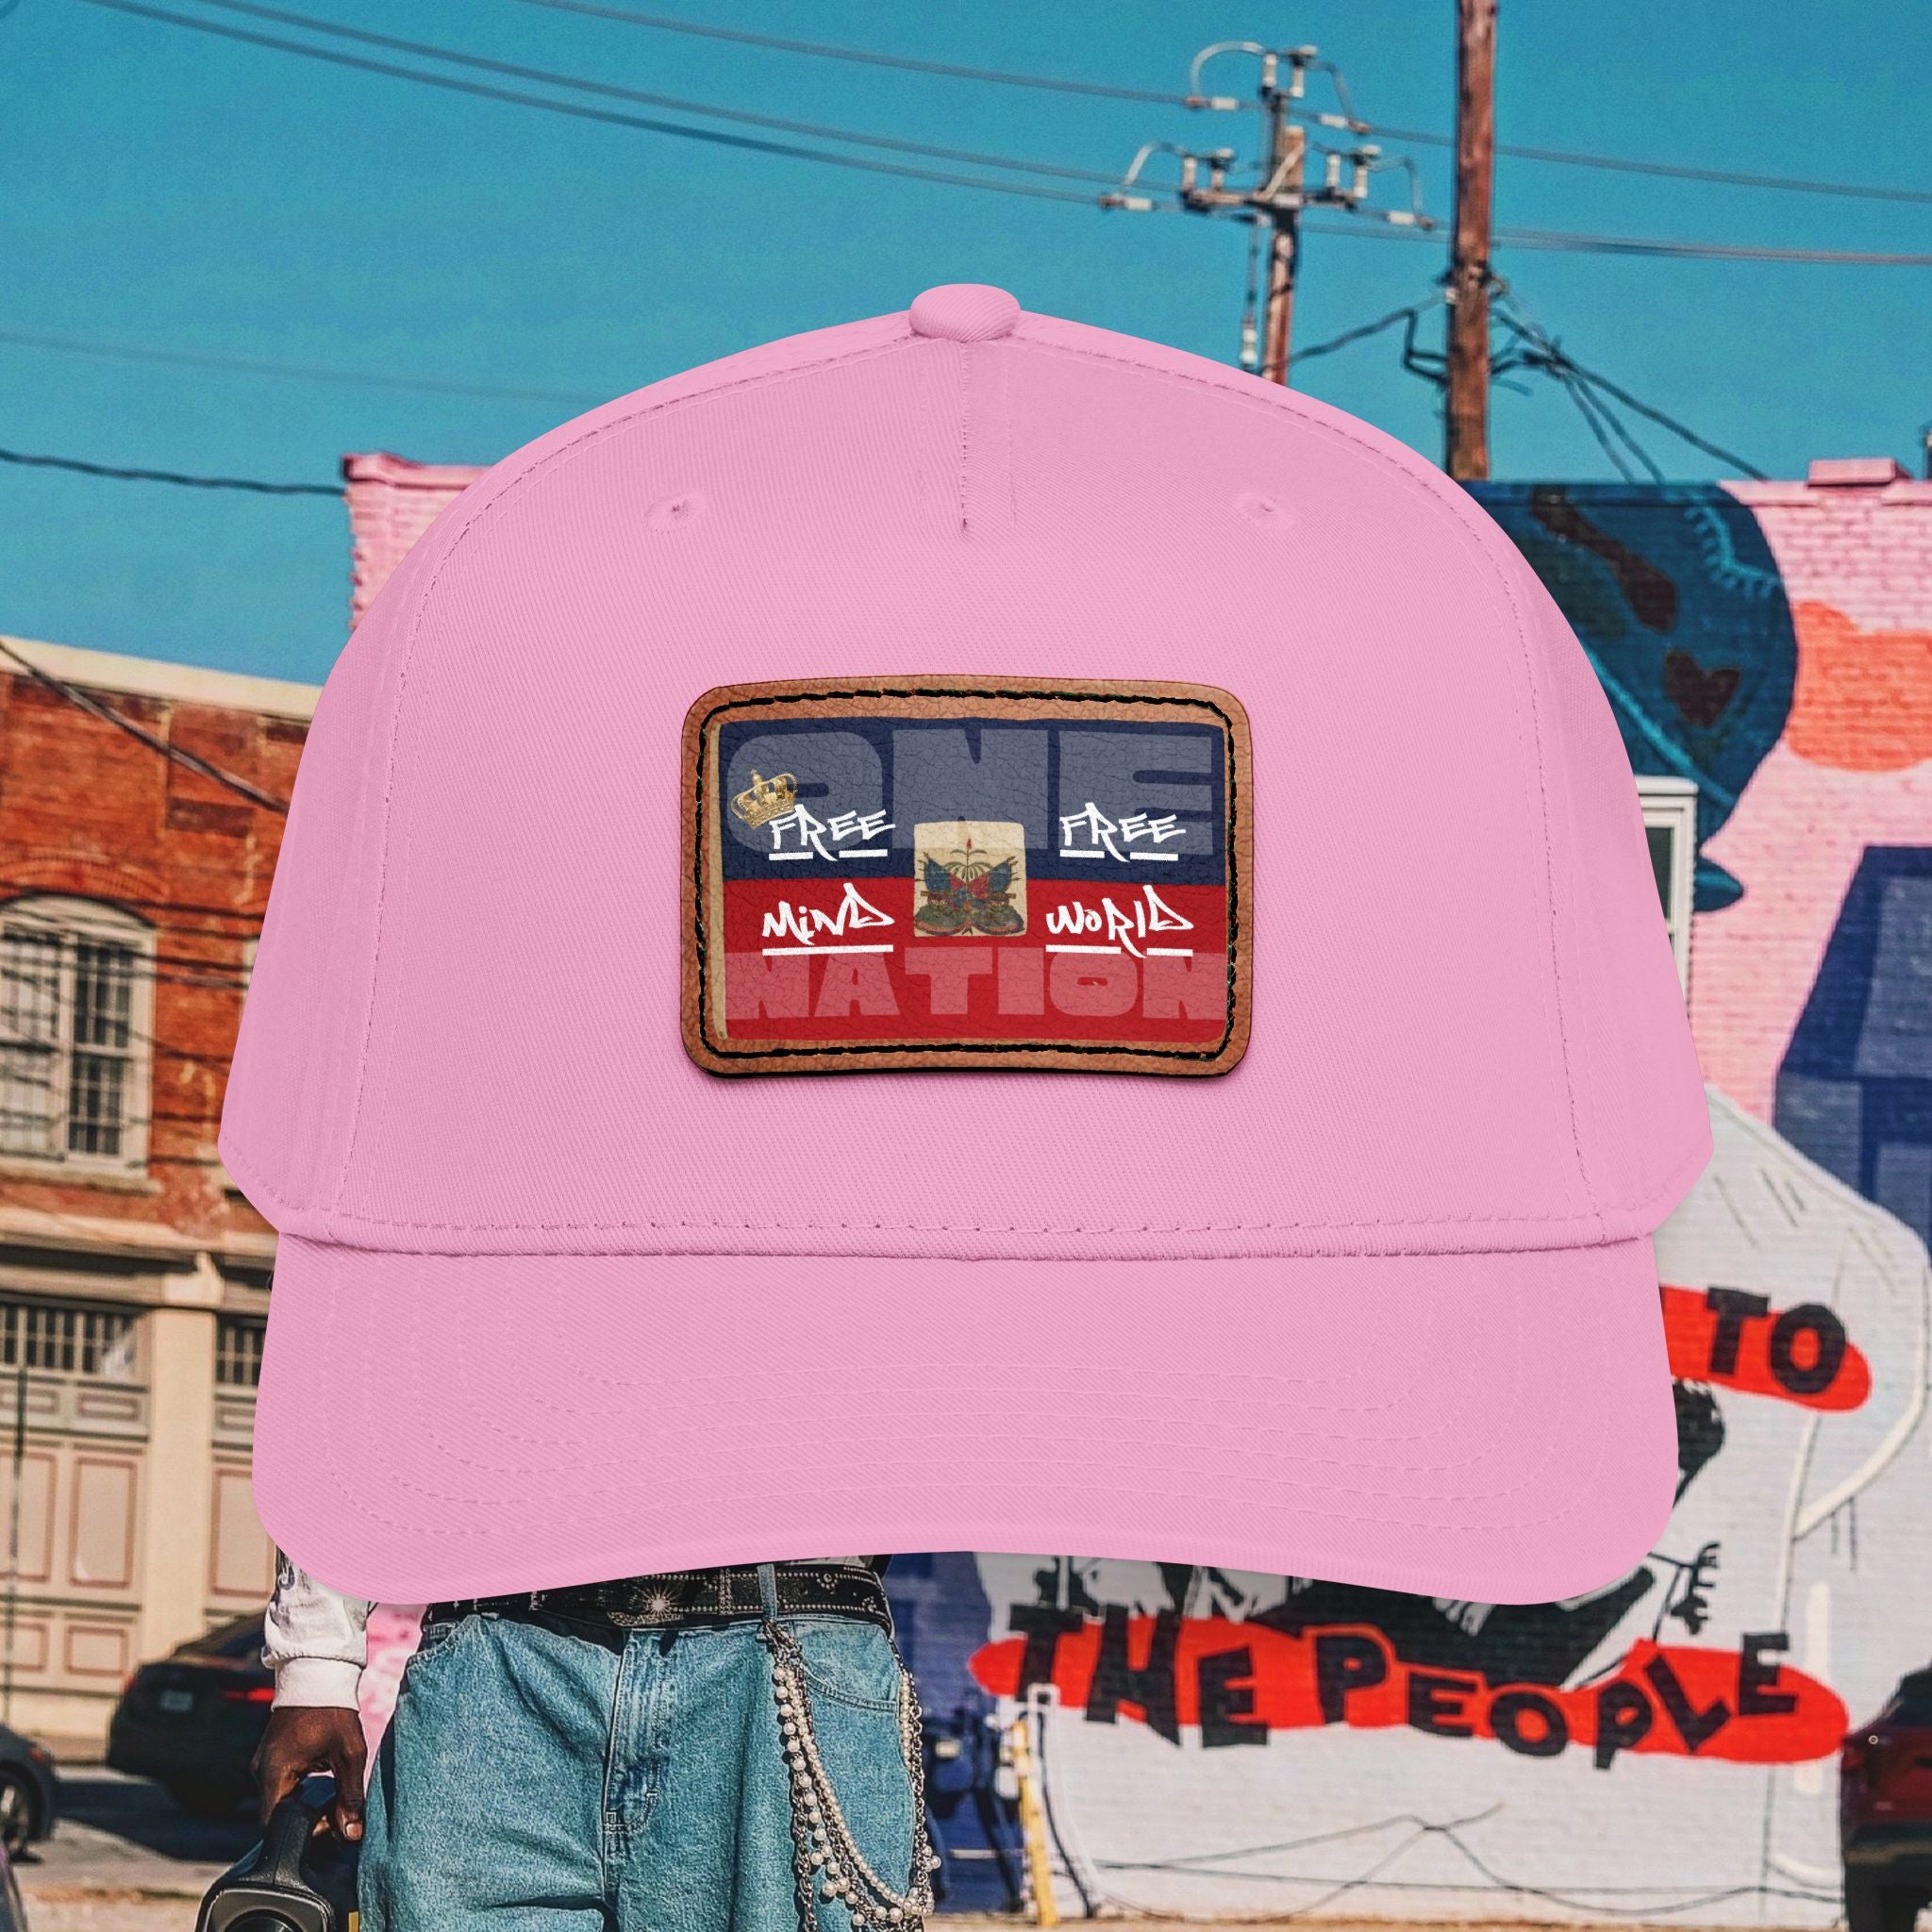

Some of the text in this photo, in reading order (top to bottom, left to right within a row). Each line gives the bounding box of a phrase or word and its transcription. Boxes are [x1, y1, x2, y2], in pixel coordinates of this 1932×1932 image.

[727, 728, 1214, 856] ONE
[769, 802, 896, 862] FREE
[1058, 802, 1187, 862] FREE
[724, 945, 1227, 1021] NATION
[1707, 1286, 1847, 1395] TO
[1008, 1603, 1798, 1772] THE PEOPLE
